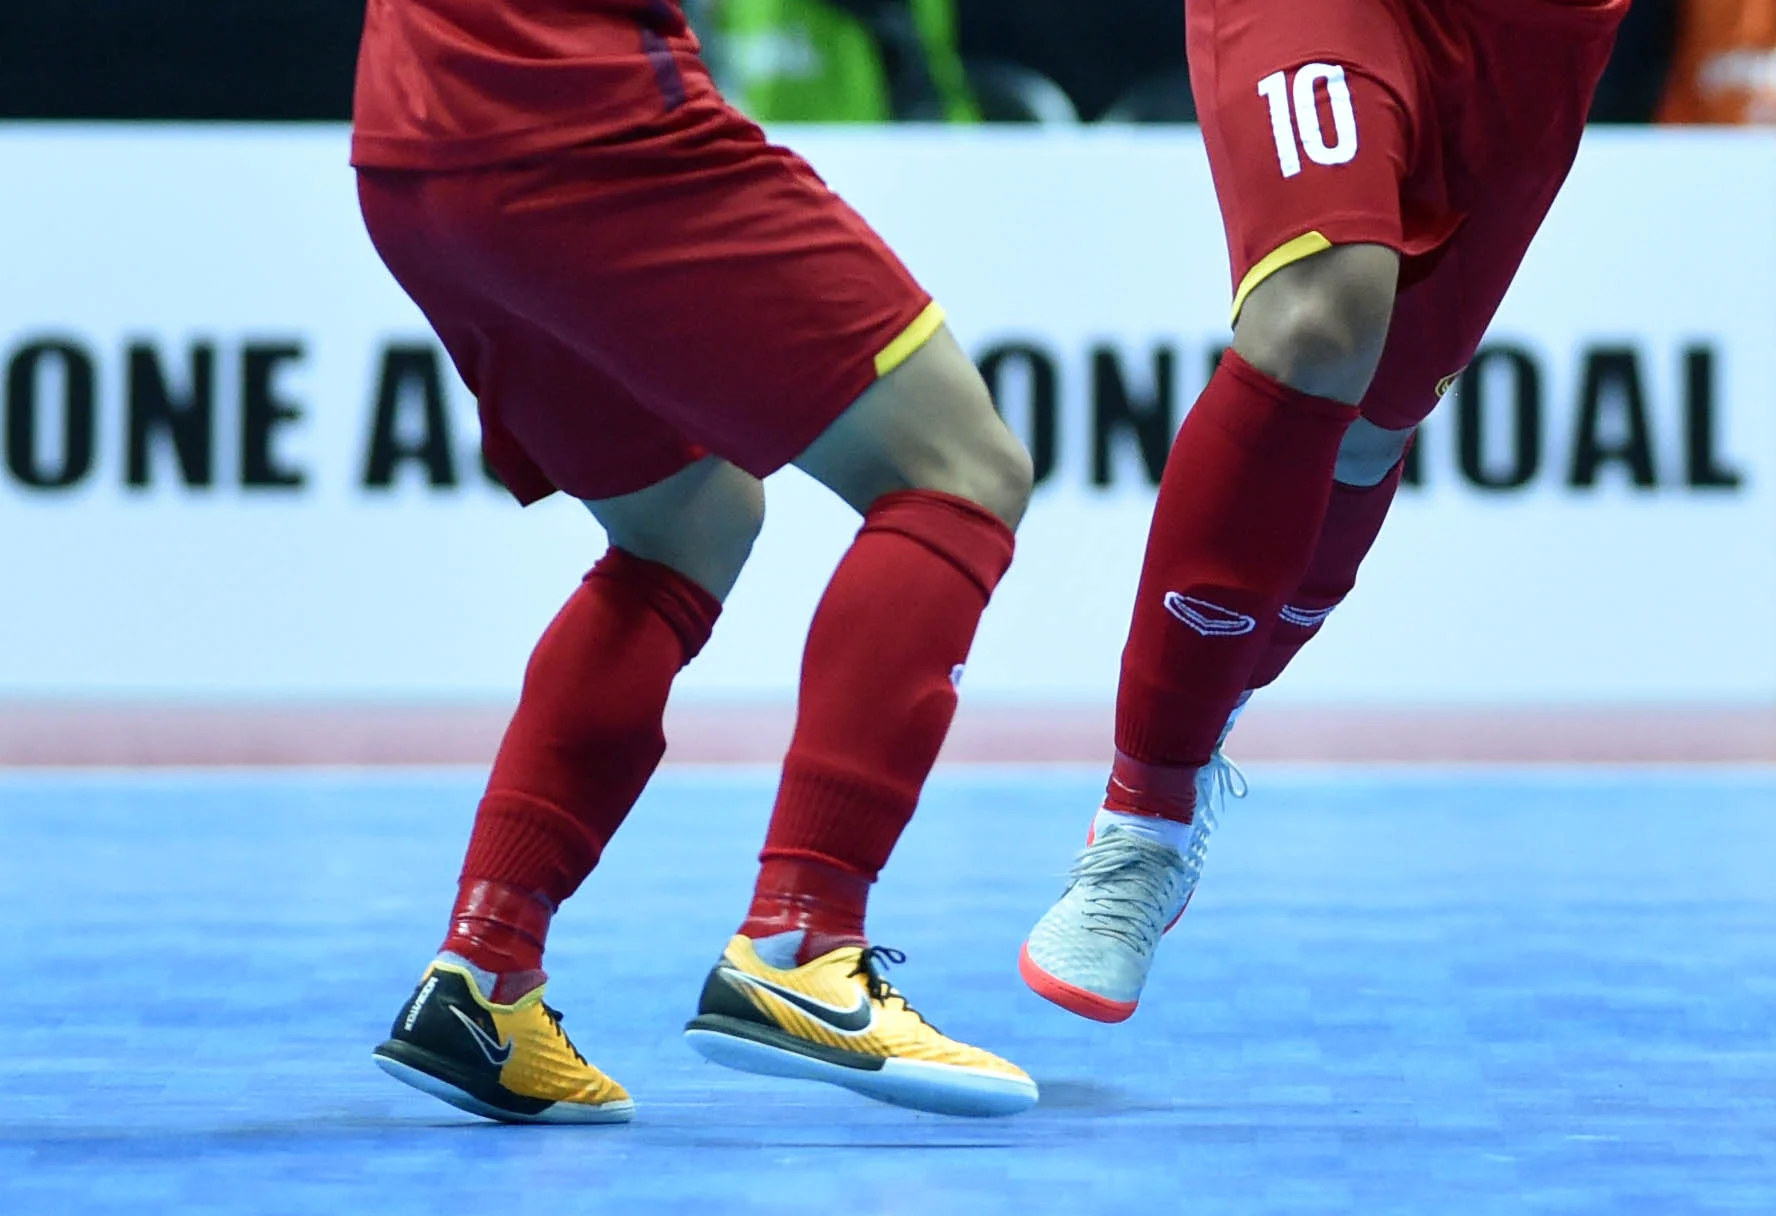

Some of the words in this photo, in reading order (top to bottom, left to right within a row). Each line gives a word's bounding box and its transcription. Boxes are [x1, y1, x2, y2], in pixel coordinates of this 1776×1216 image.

[1257, 62, 1358, 179] 10
[3, 339, 307, 492] ONE
[973, 337, 1232, 492] ON
[1400, 337, 1745, 492] OAL
